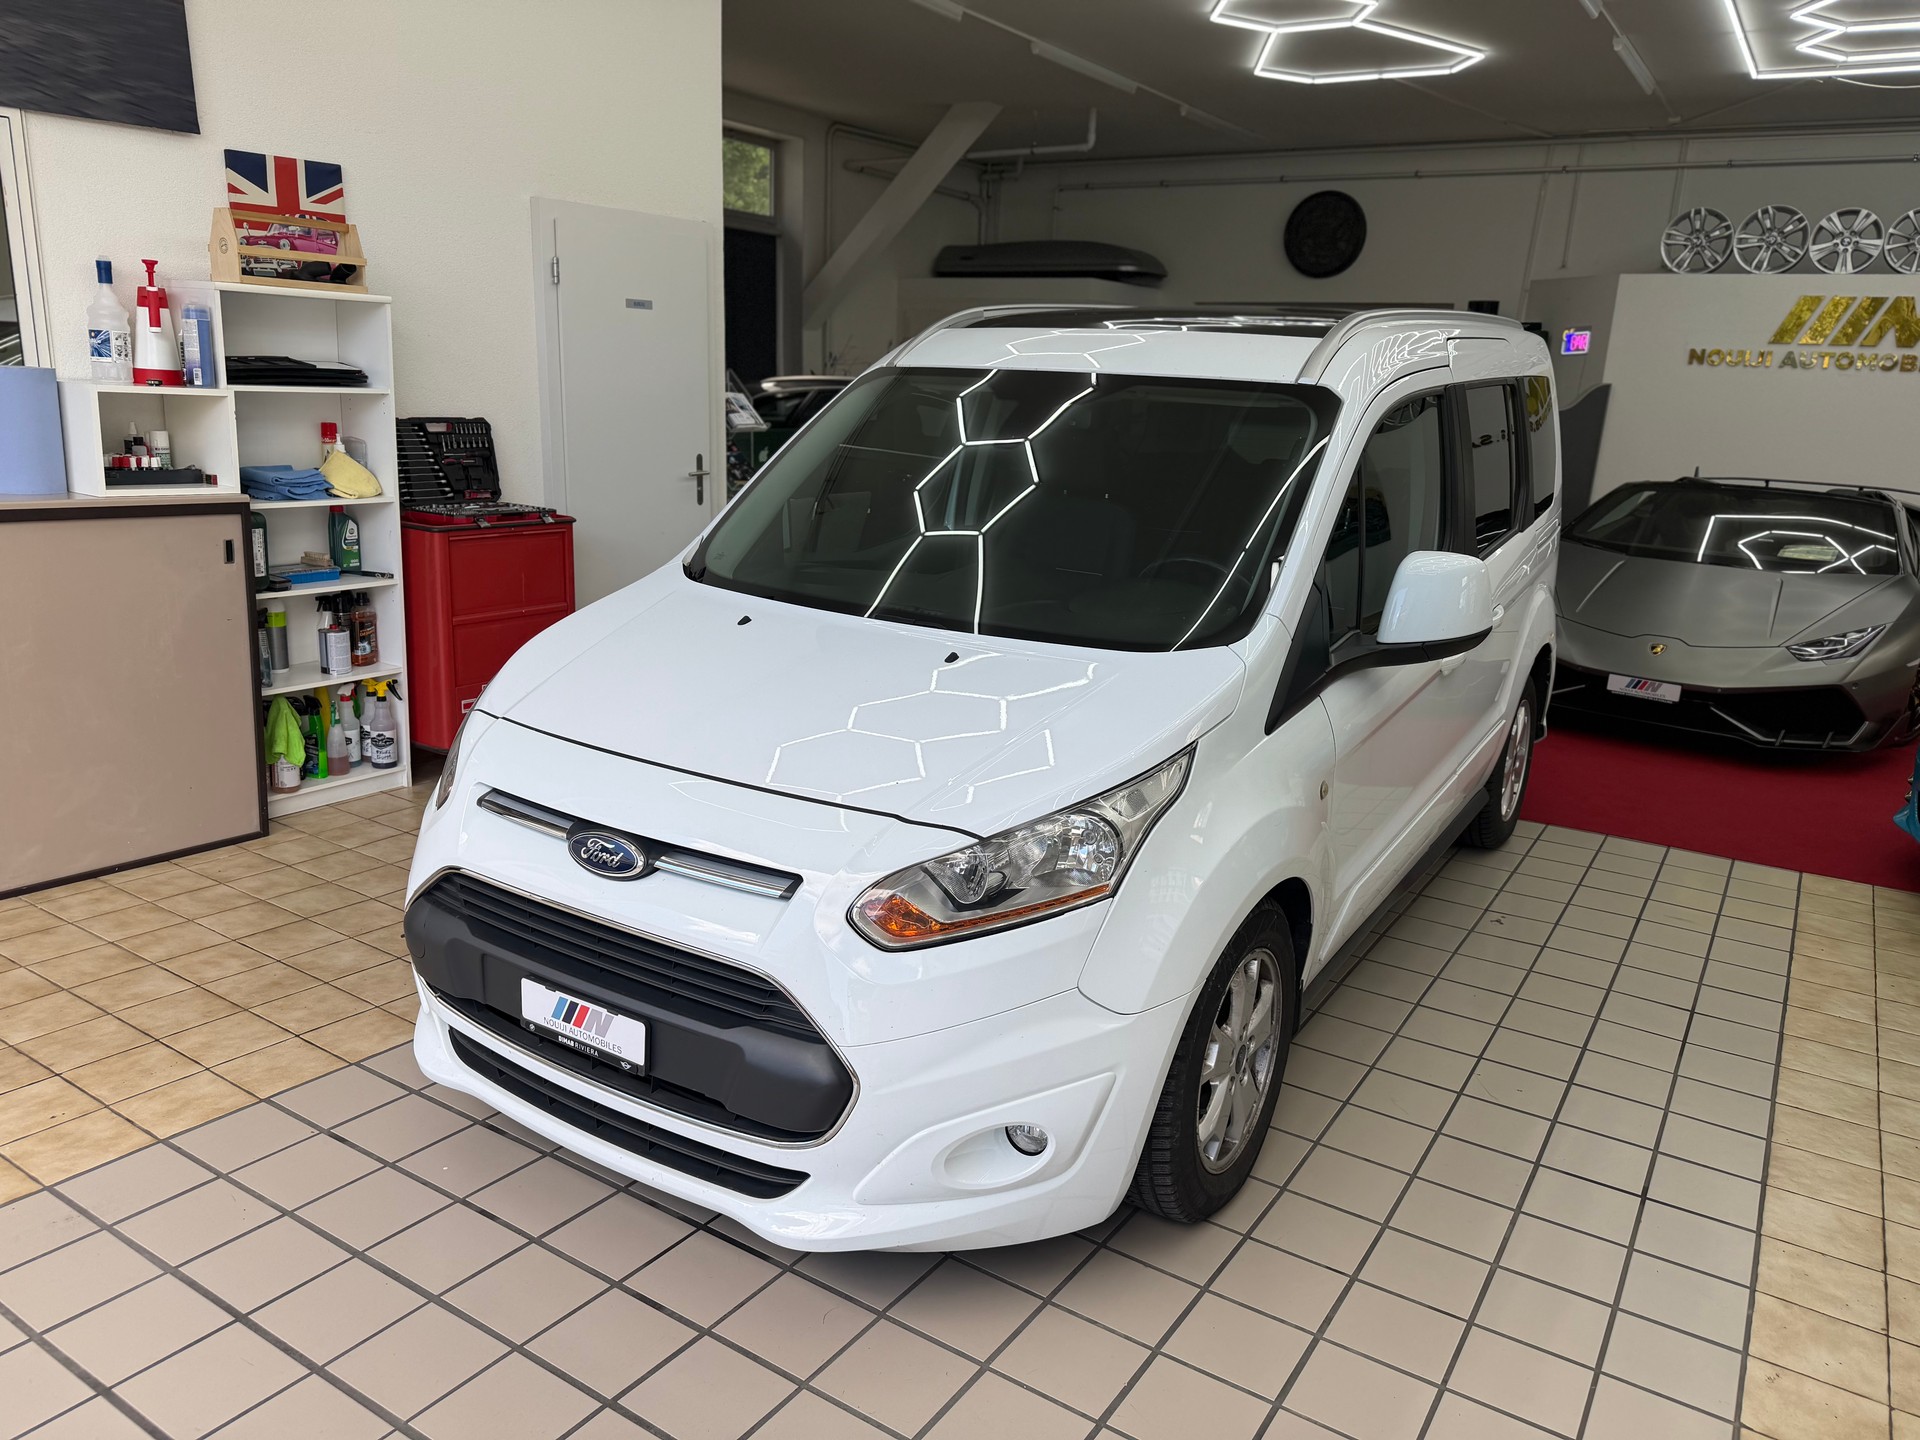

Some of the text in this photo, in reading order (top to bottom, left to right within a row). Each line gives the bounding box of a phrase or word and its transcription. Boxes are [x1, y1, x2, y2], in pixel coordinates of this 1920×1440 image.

[1778, 350, 1920, 373] AUTOMOB
[581, 838, 624, 868] Ford
[543, 1016, 623, 1055] NOUIJI AUTOMOBILES
[574, 1041, 599, 1057] RIVIERA
